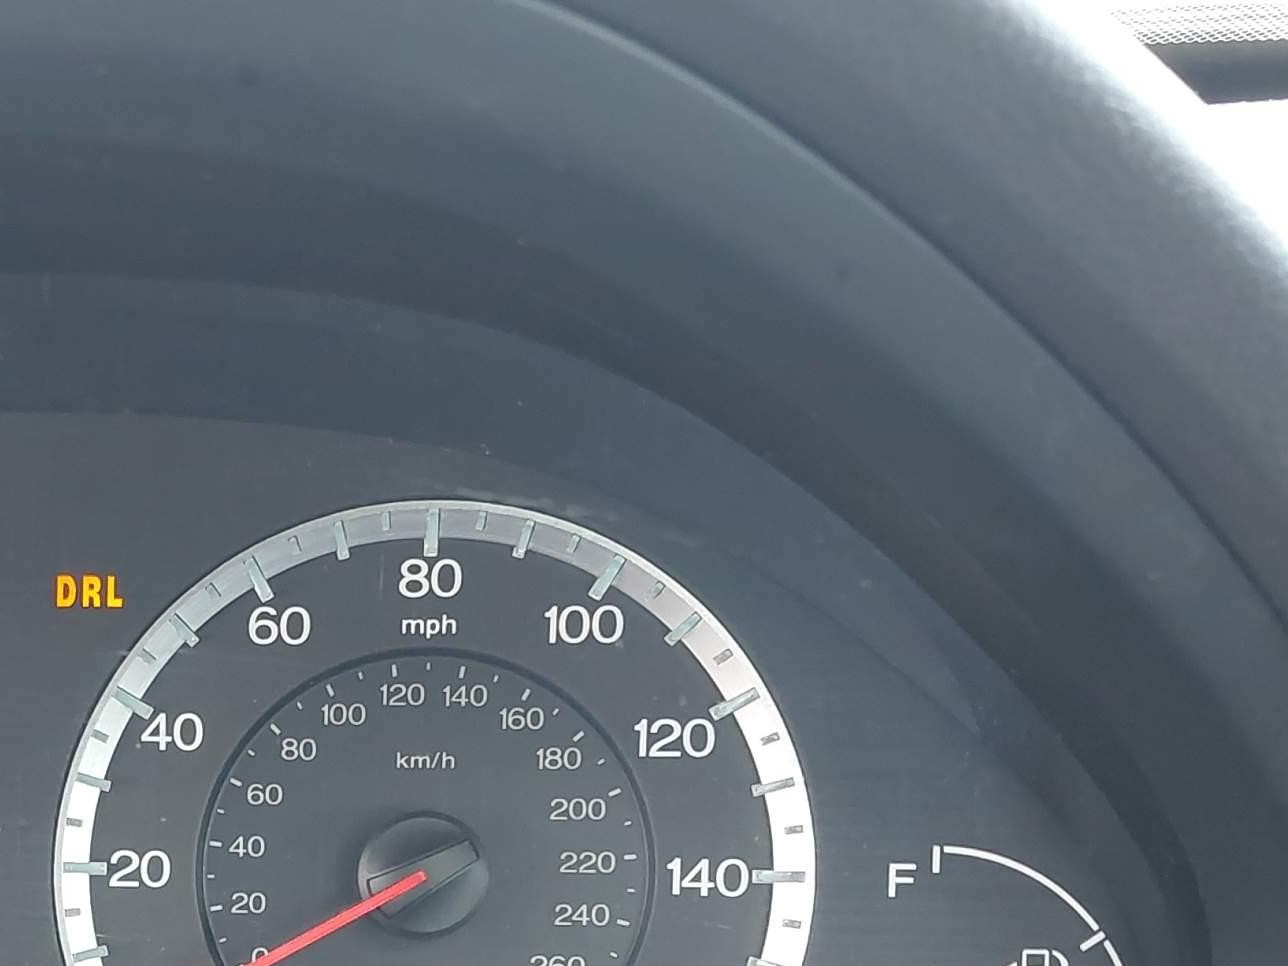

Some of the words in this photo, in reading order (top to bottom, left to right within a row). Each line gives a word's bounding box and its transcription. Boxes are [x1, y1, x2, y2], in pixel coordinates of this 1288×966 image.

[398, 559, 462, 598] 80
[56, 576, 124, 607] DRL
[249, 606, 310, 645] 60
[401, 615, 457, 638] mph
[547, 605, 623, 643] 100
[381, 684, 424, 706] 120
[443, 685, 487, 708] 140
[322, 704, 366, 726] 100
[500, 708, 544, 730] 160
[141, 714, 203, 751] 40
[635, 720, 714, 757] 120
[281, 739, 316, 761] 80
[396, 751, 455, 771] km/h
[537, 748, 582, 770] 180
[247, 784, 283, 806] 60
[550, 799, 606, 821] 200
[230, 836, 265, 857] 40
[110, 850, 170, 887] 20
[560, 852, 616, 874] 220
[667, 858, 748, 897] 140
[888, 863, 916, 897] F
[231, 893, 266, 914] 20
[554, 904, 610, 926] 240
